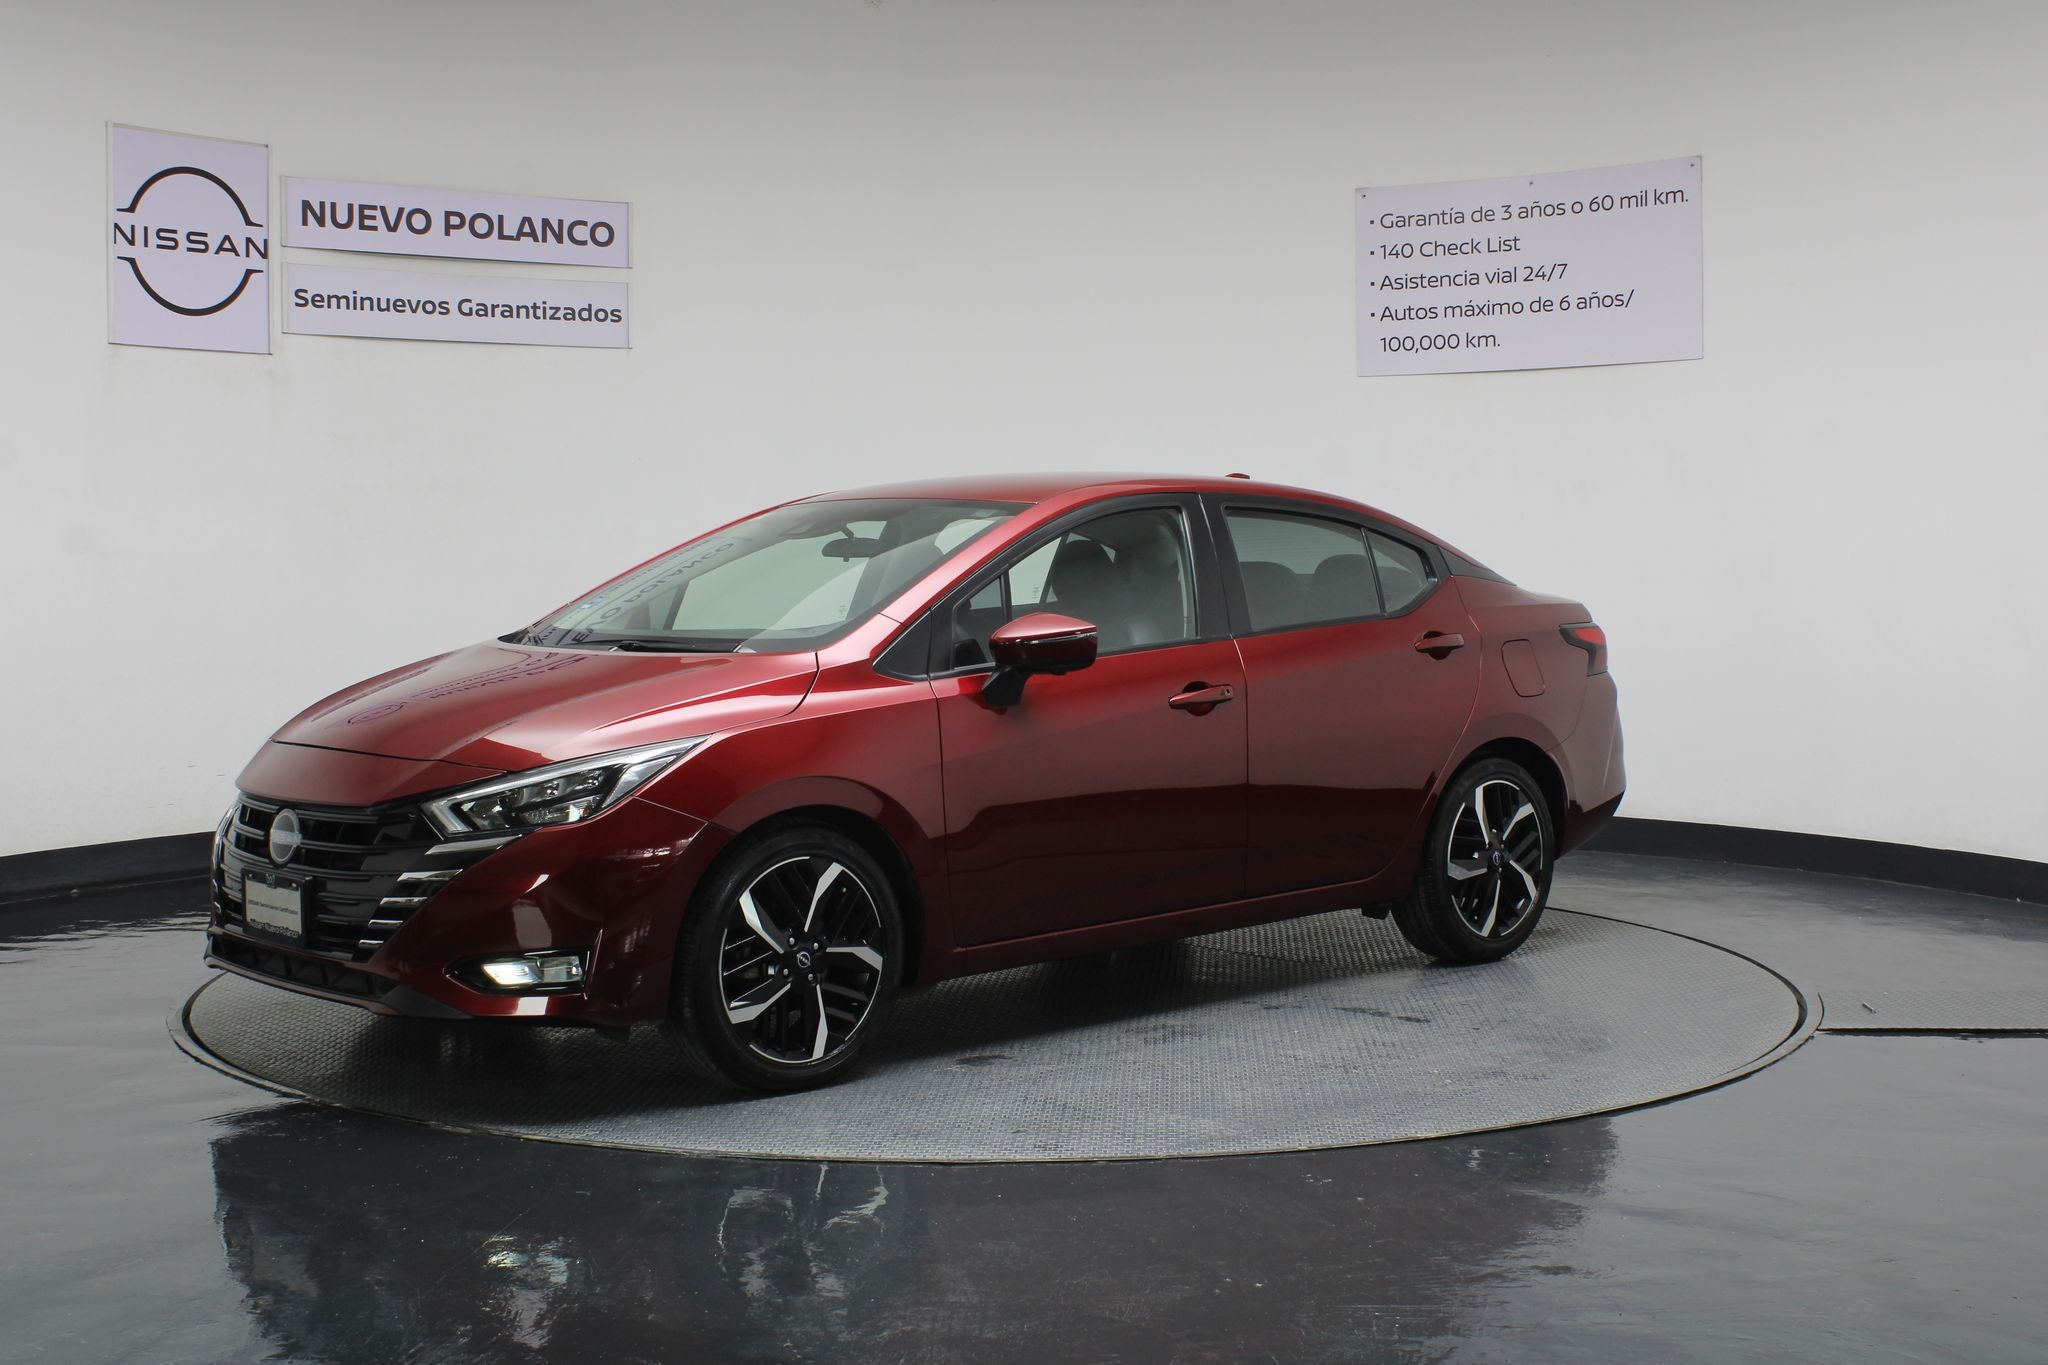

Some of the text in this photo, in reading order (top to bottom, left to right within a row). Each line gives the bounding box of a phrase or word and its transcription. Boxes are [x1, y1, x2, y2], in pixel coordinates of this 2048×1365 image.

[301, 200, 615, 248] NUEVO POLANCO
[1380, 189, 1689, 229] Garantía de 3 años o 60 mil km.
[114, 223, 268, 260] NISSAN
[1380, 236, 1521, 259] 140 Check List
[1380, 264, 1568, 290] Asistencia vial 24/7
[294, 289, 623, 323] Seminuevos Garantizados
[1380, 289, 1635, 322] Autos máximo de 6 años/
[1380, 332, 1501, 354] 100,000 km.
